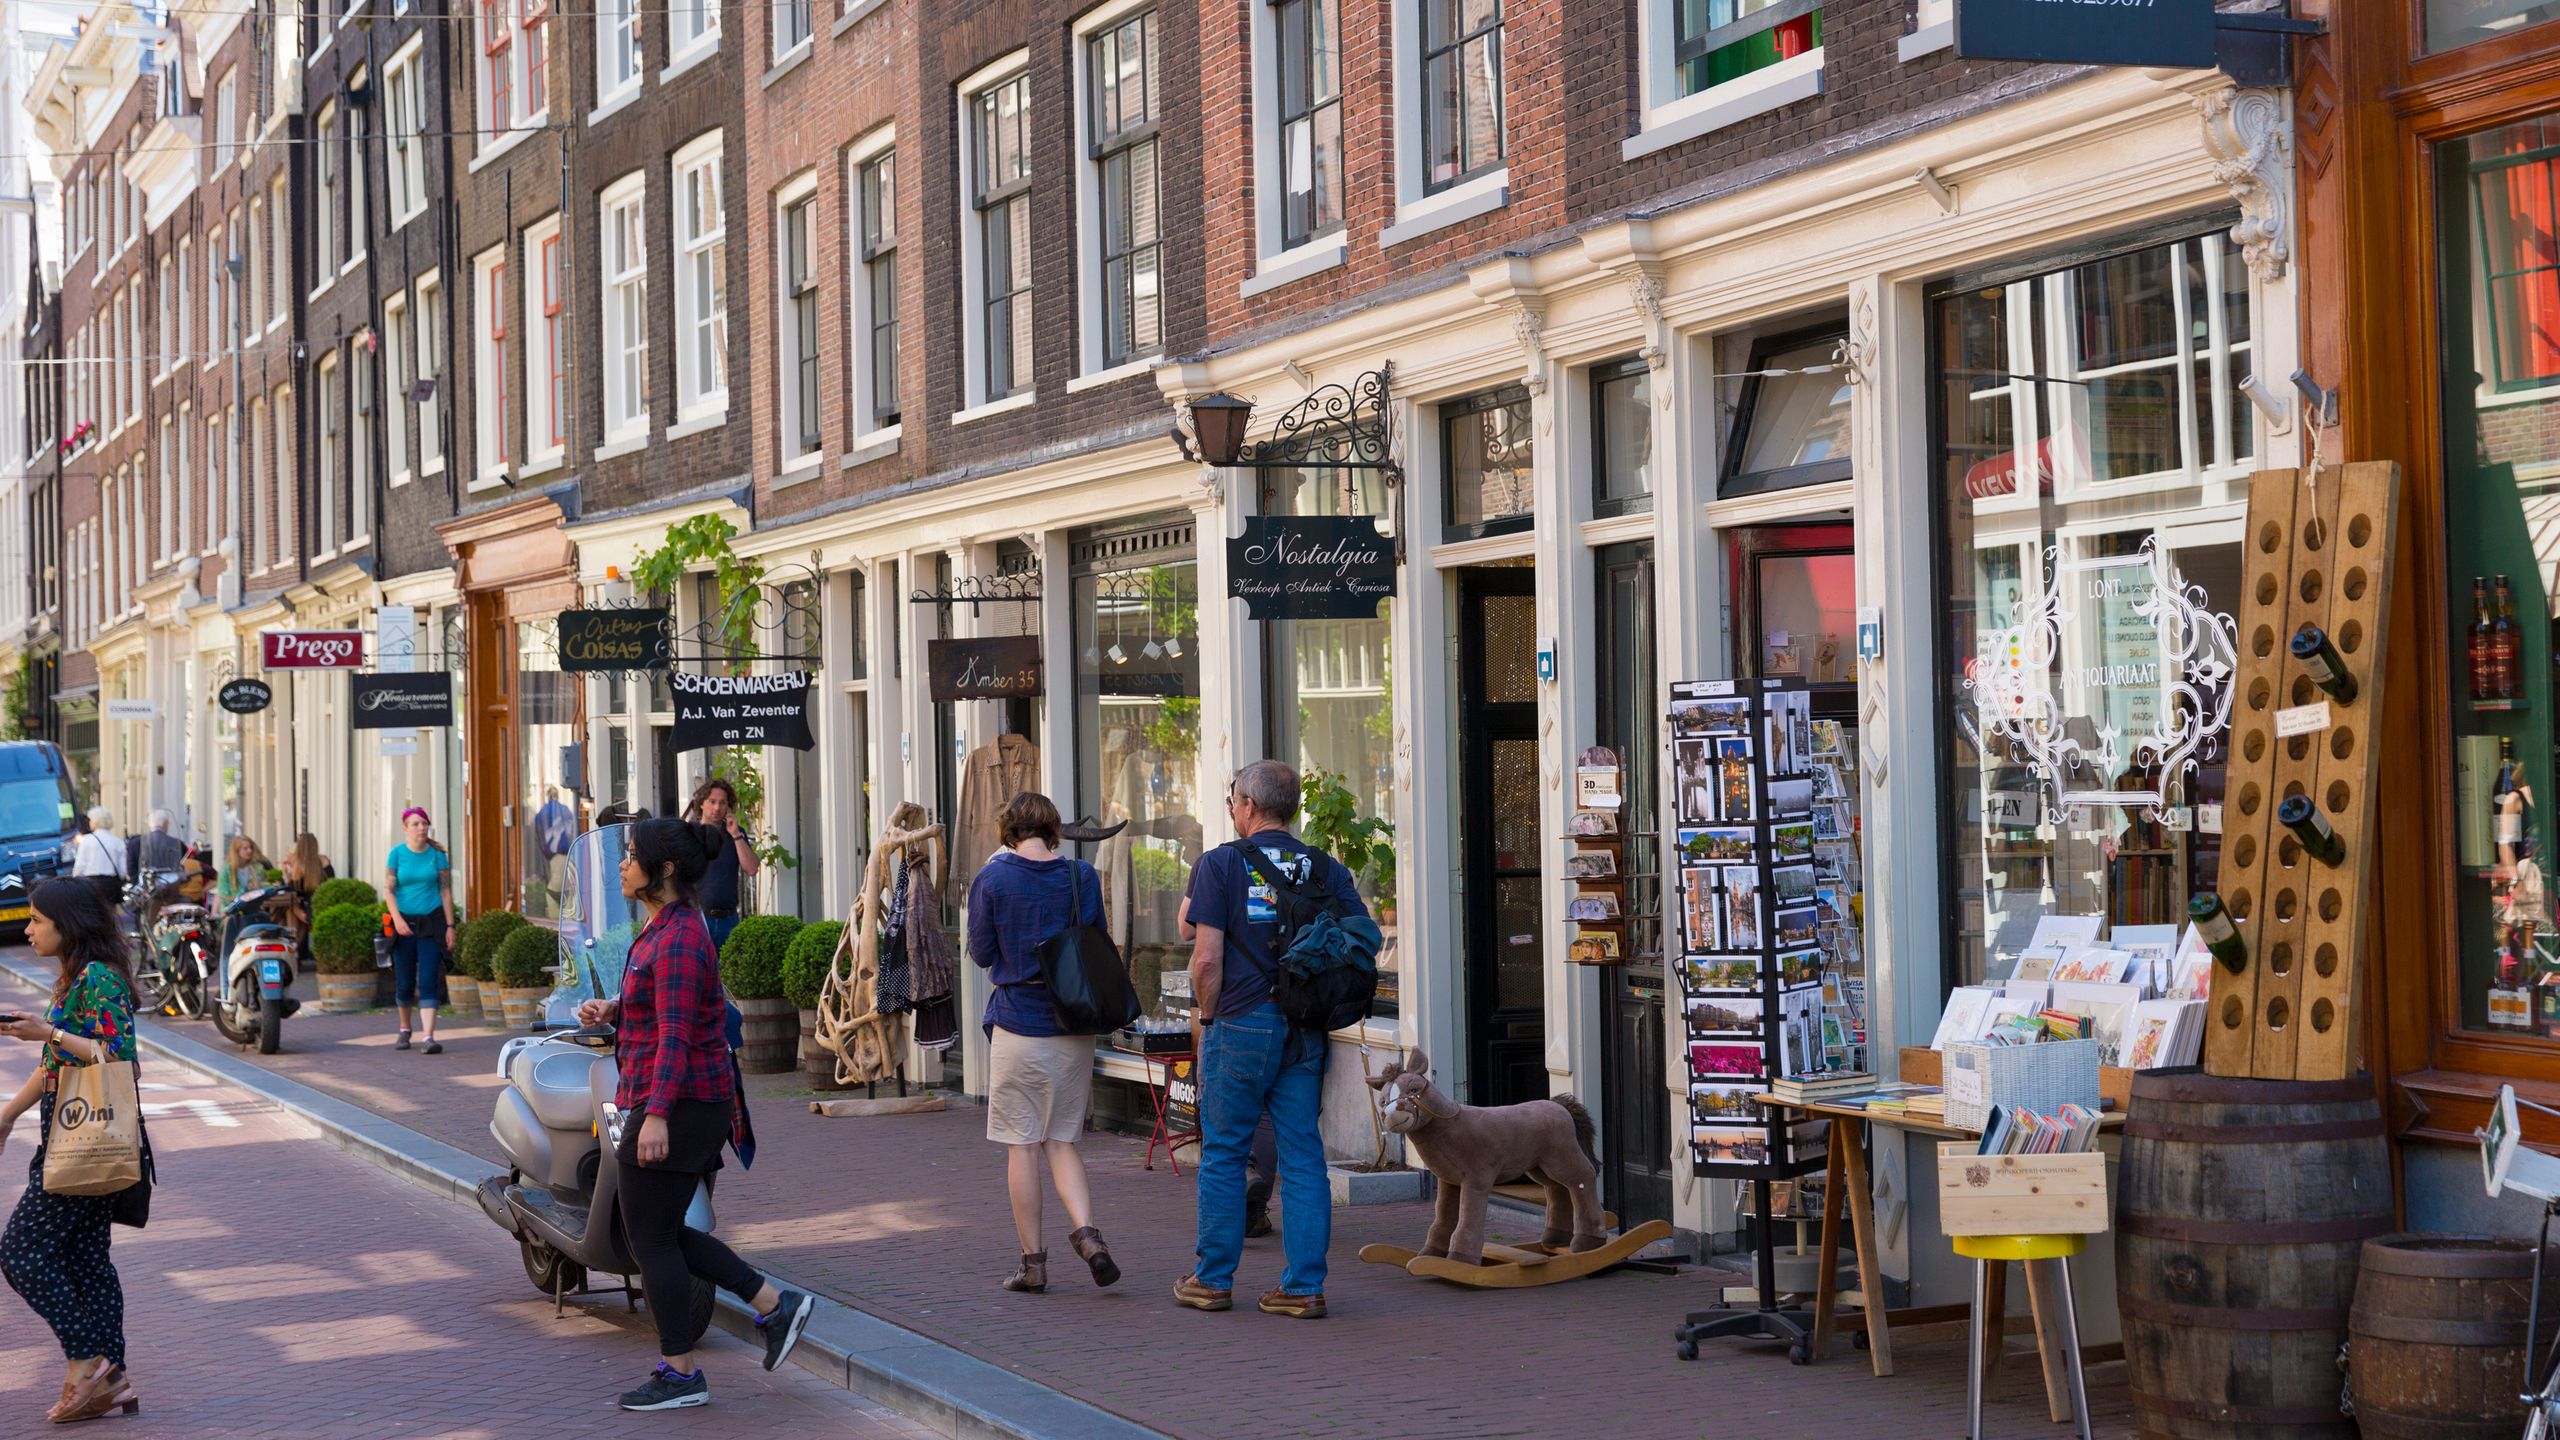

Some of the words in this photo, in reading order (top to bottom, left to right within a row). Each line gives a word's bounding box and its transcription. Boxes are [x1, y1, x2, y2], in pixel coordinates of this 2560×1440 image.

[1245, 534, 1378, 577] Nostalgia
[1234, 578, 1281, 597] Verkoop
[1286, 578, 1332, 593] Antiek
[1346, 577, 1391, 593] Curiosa
[2088, 579, 2121, 599] LONT
[585, 616, 658, 640] Outras
[274, 634, 353, 666] Prego
[674, 670, 806, 695] SCHOENMAKERIJ
[956, 656, 1014, 689] Amber
[1019, 669, 1035, 689] 35
[682, 707, 706, 719] A.J.
[711, 706, 736, 718] Van
[741, 704, 800, 717] Zeventer
[723, 729, 739, 739] en
[745, 727, 764, 739] ZN
[1583, 780, 1596, 789] 3D
[63, 1102, 114, 1126] Wini
